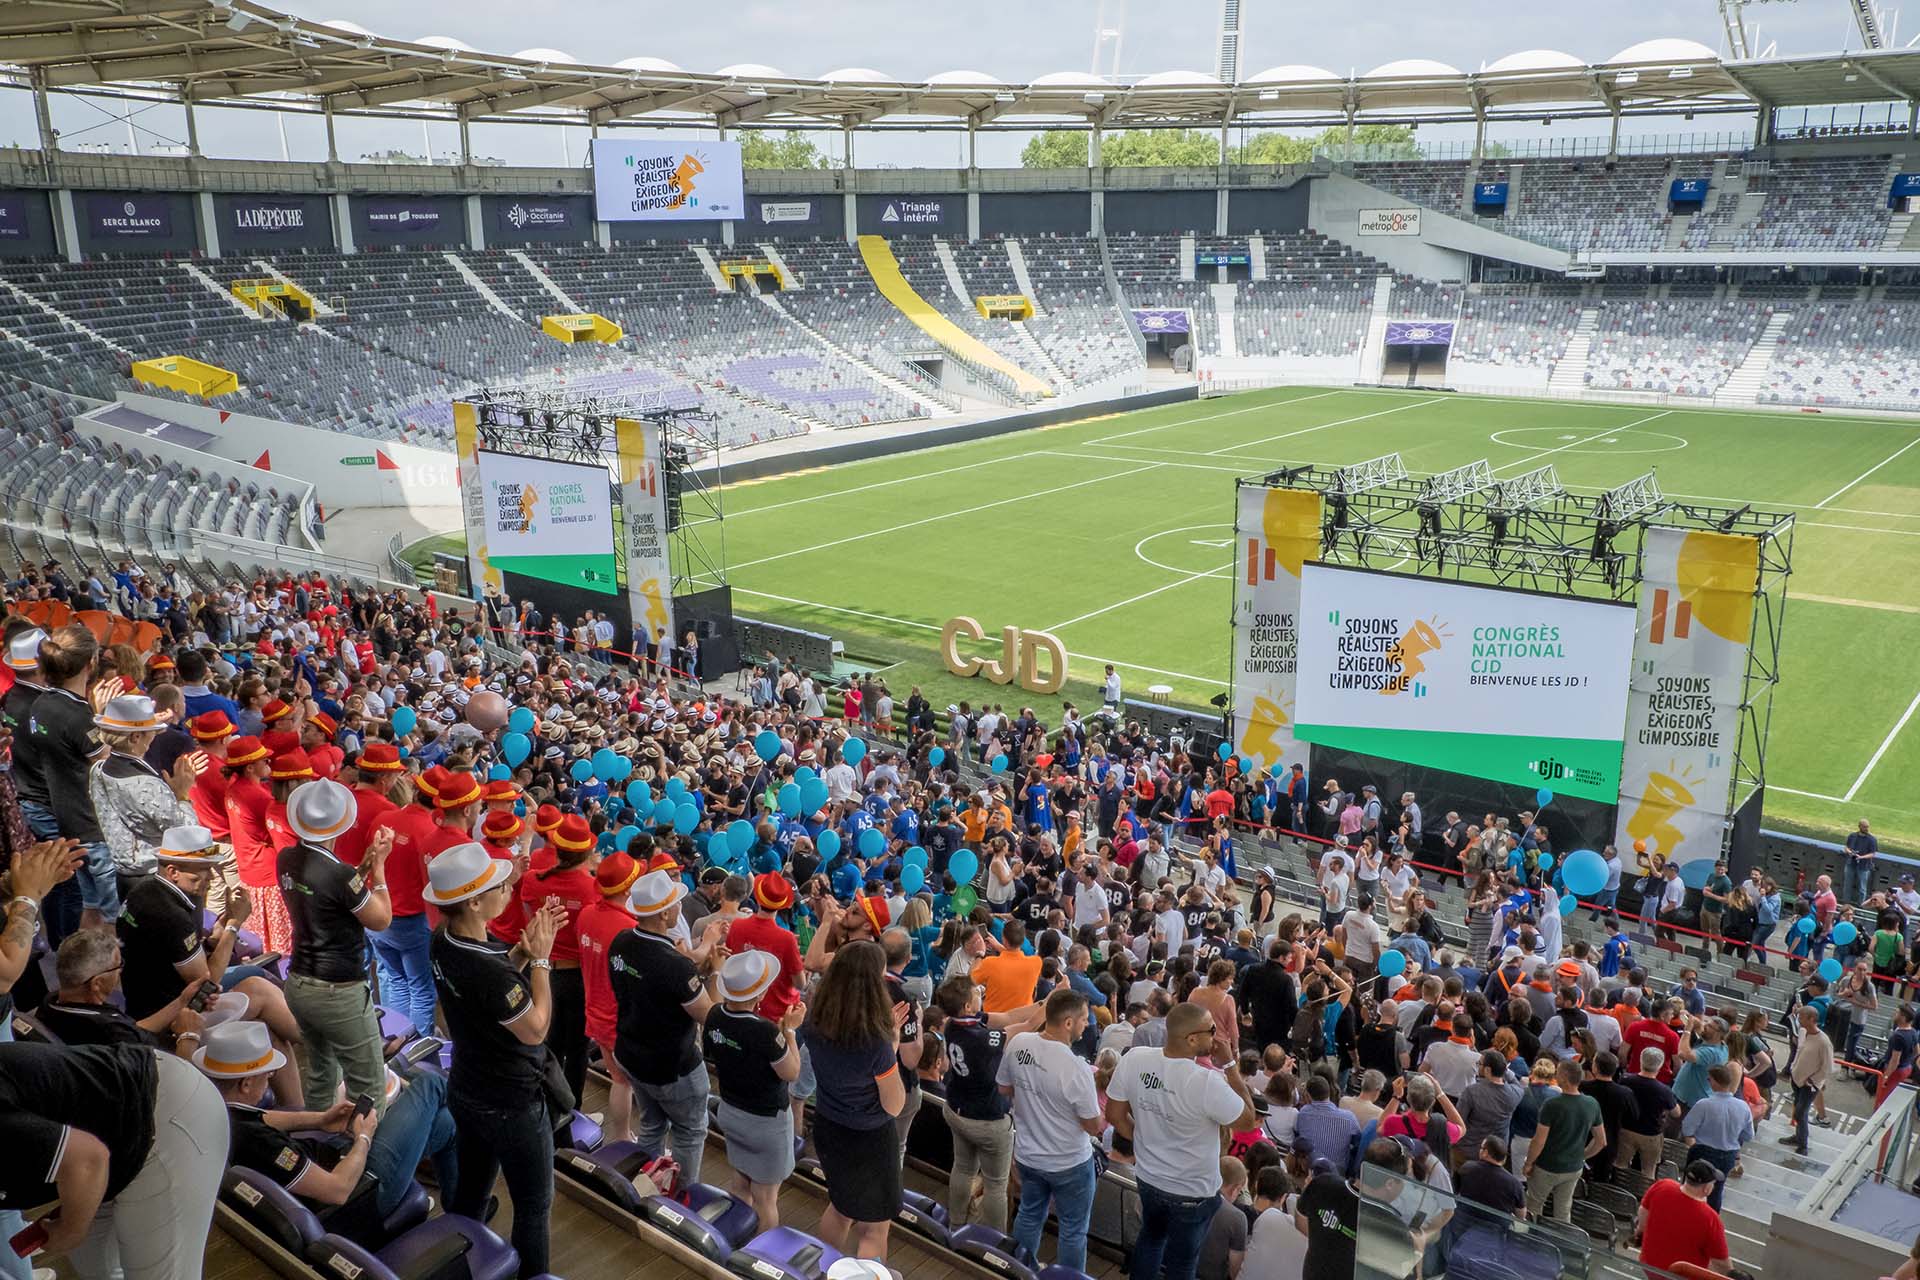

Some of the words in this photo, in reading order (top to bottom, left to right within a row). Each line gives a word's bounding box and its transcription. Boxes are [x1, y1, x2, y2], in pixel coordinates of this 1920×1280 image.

[638, 156, 674, 171] SOYONS
[900, 202, 940, 212] Triangle
[102, 218, 127, 226] SERGE
[130, 218, 161, 226] BLANCO
[236, 209, 252, 227] LA
[252, 207, 304, 227] DÉPÊCHE
[530, 212, 564, 220] Occitanie
[903, 212, 938, 222] intérim
[1378, 213, 1418, 223] toulouse
[549, 495, 587, 506] NATIONAL
[1255, 614, 1293, 628] SOYONS
[1345, 619, 1399, 635] SOYONS
[1473, 623, 1560, 641] CONGRÈS
[941, 616, 1069, 694] CJD
[1472, 643, 1566, 658] NATIONAL
[1471, 659, 1502, 673] CJD
[1470, 675, 1538, 686] BIENVENUE
[1541, 676, 1561, 687] LES
[1564, 676, 1579, 687] JD
[1656, 677, 1711, 693] SOYONS
[864, 800, 877, 816] 45
[858, 815, 873, 830] 45
[908, 814, 919, 830] 45
[1030, 903, 1049, 919] 54
[904, 1021, 917, 1036] 88
[988, 1030, 1001, 1047] 88
